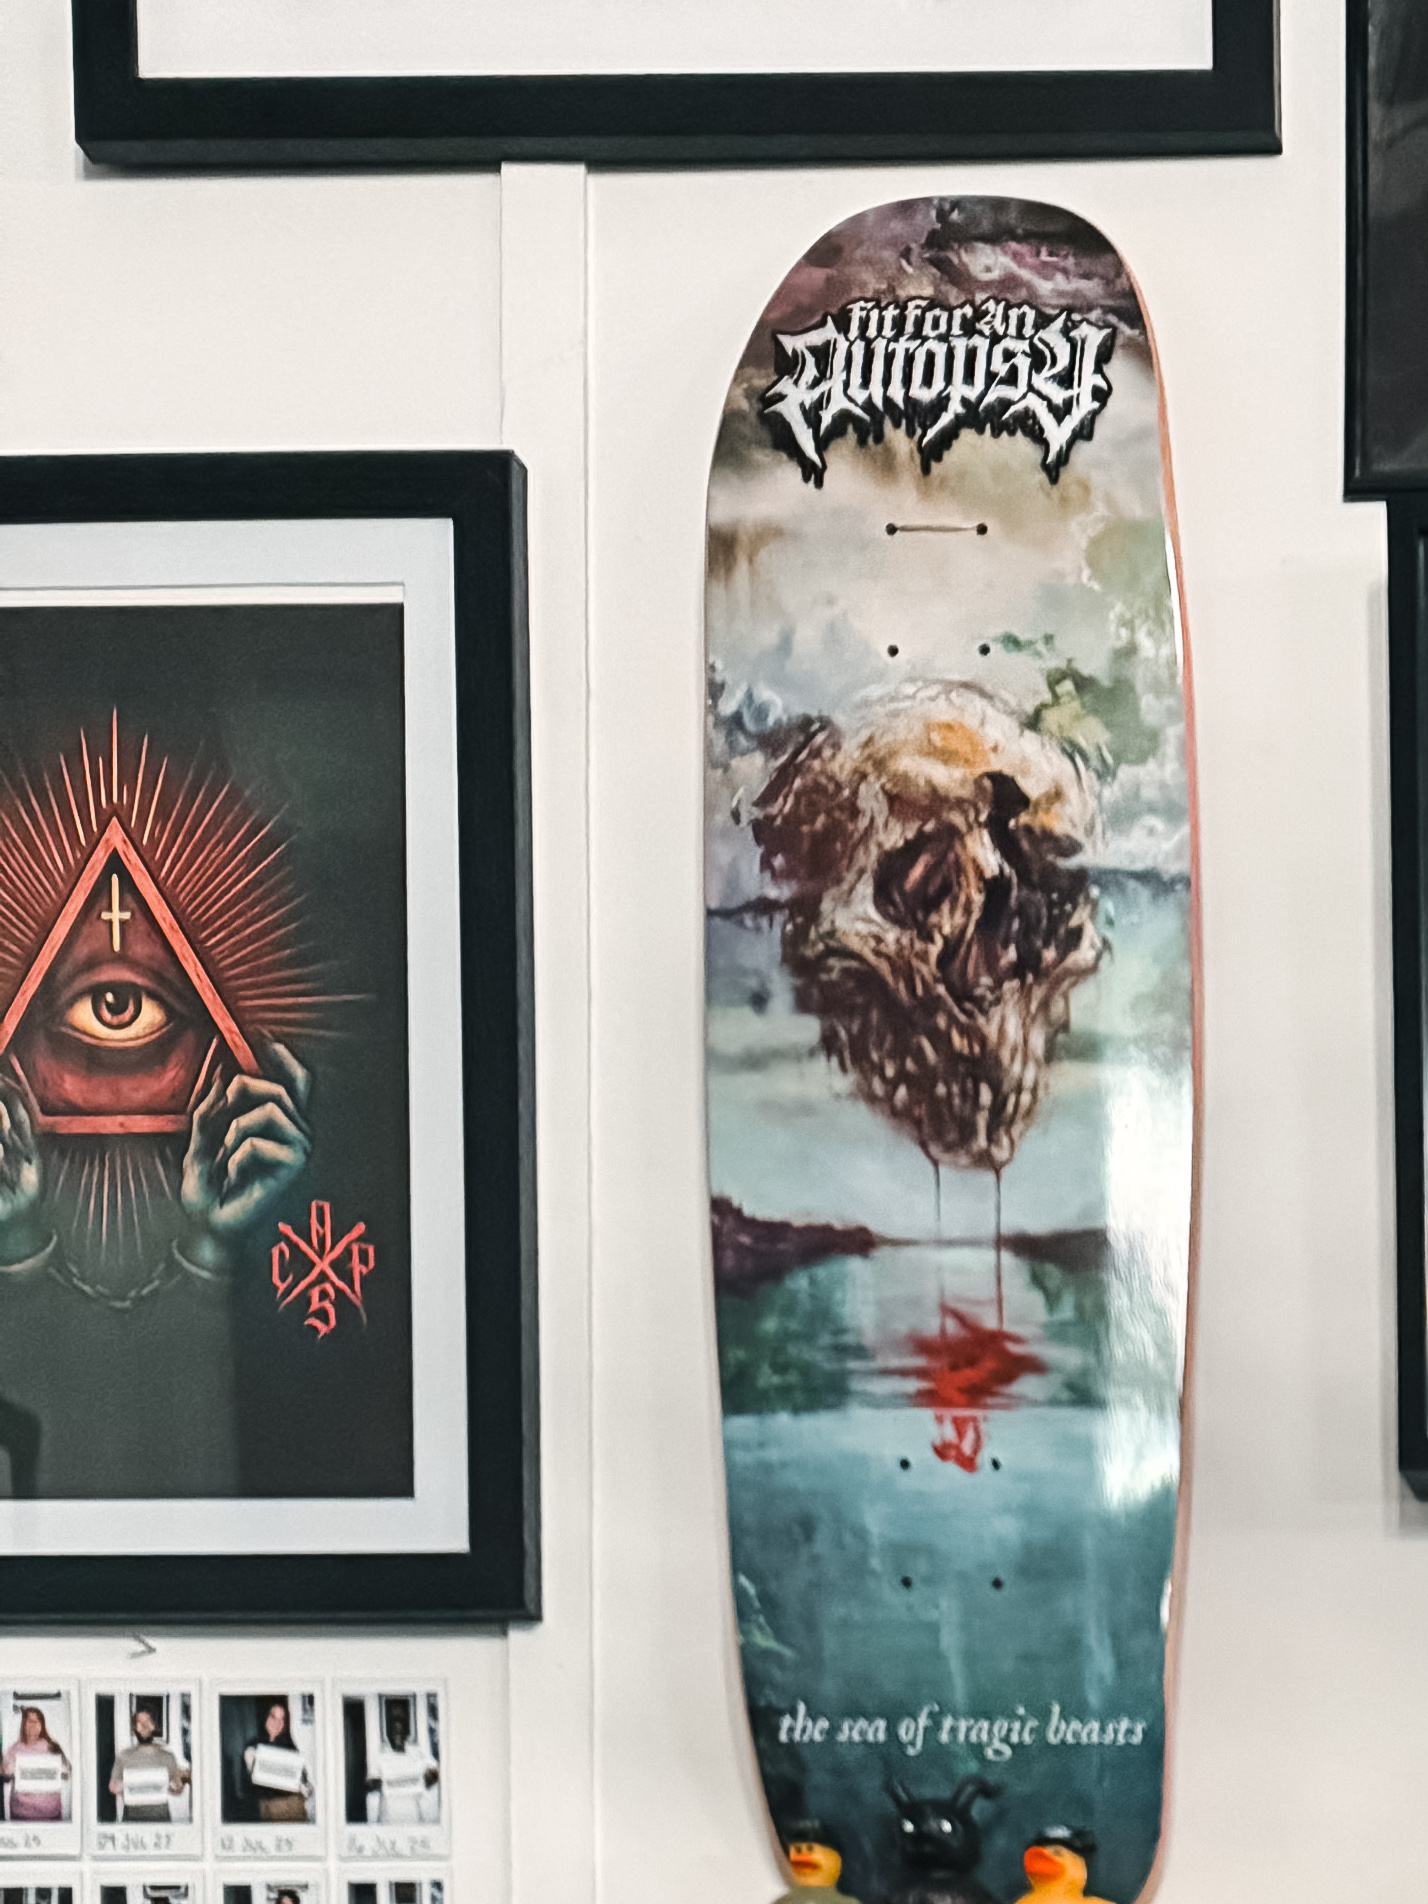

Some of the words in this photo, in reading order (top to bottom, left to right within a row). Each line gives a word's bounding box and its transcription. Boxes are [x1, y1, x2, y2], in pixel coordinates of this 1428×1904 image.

[847, 301, 895, 339] Fit
[900, 301, 974, 338] For
[975, 300, 1036, 338] An
[763, 311, 1116, 469] Autopsy
[778, 1700, 830, 1746] the
[837, 1710, 886, 1745] sea
[898, 1701, 940, 1757] of
[940, 1702, 1039, 1761] tragic
[1047, 1703, 1148, 1747] beasts
